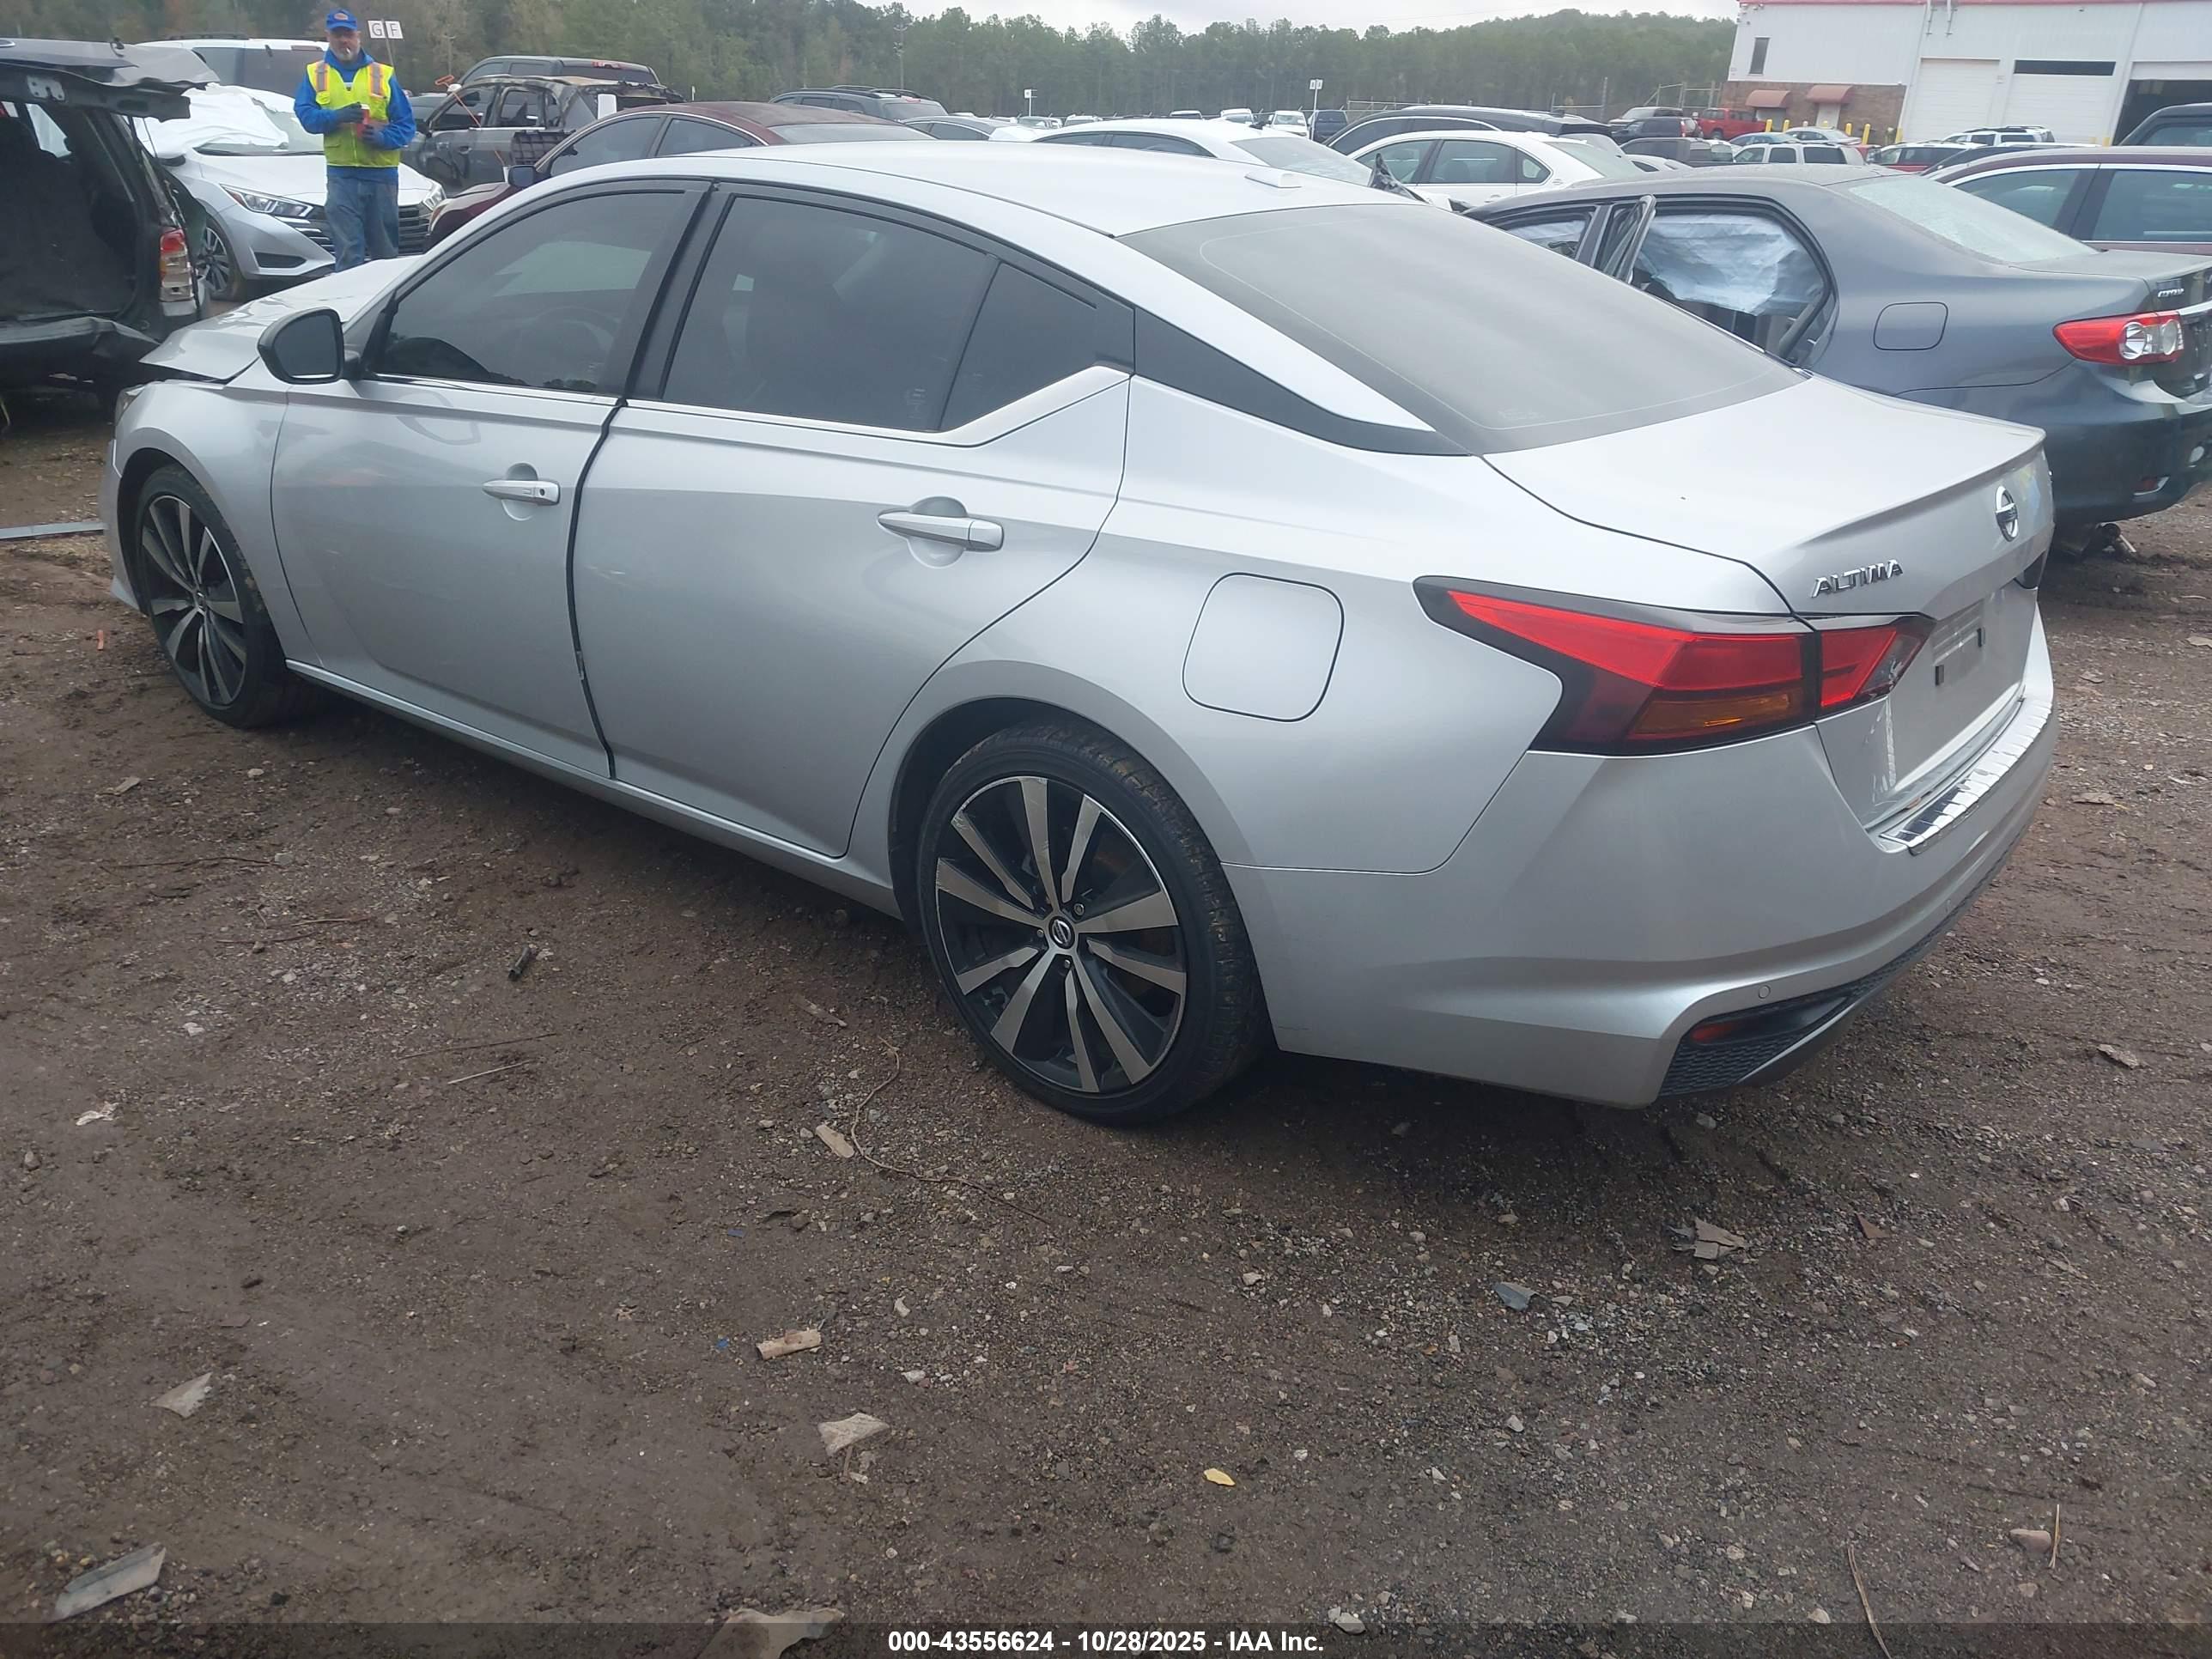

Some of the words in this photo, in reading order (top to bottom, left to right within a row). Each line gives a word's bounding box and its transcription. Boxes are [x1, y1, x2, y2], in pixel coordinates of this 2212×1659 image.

[371, 22, 383, 36] G
[389, 22, 399, 37] F
[1810, 559, 1904, 598] ALTIMA
